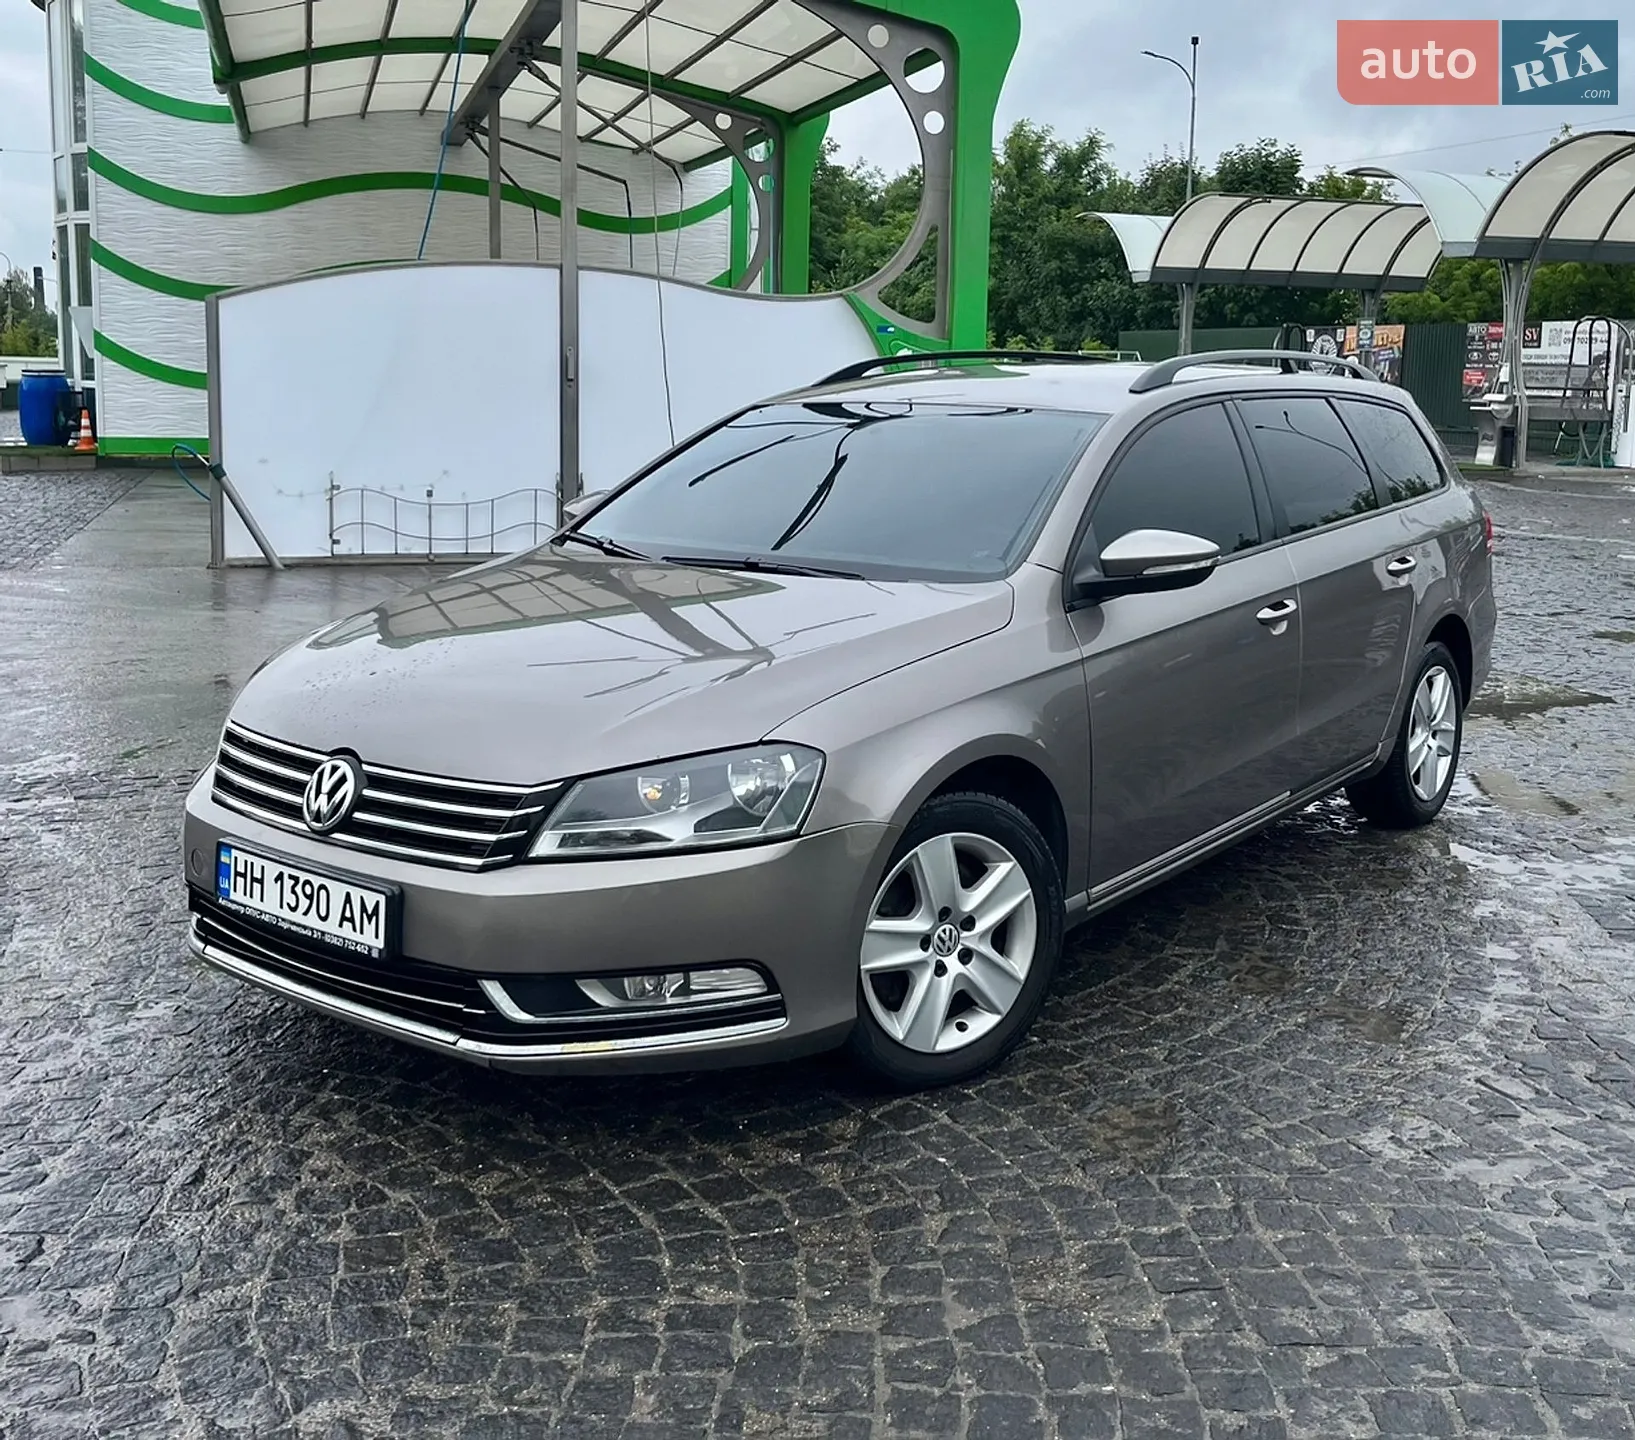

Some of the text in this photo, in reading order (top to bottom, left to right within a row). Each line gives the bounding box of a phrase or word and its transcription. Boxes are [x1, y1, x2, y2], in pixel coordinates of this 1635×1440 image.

[1524, 328, 1539, 340] SV
[219, 876, 230, 889] UA
[233, 856, 380, 940] HH 1390 AM
